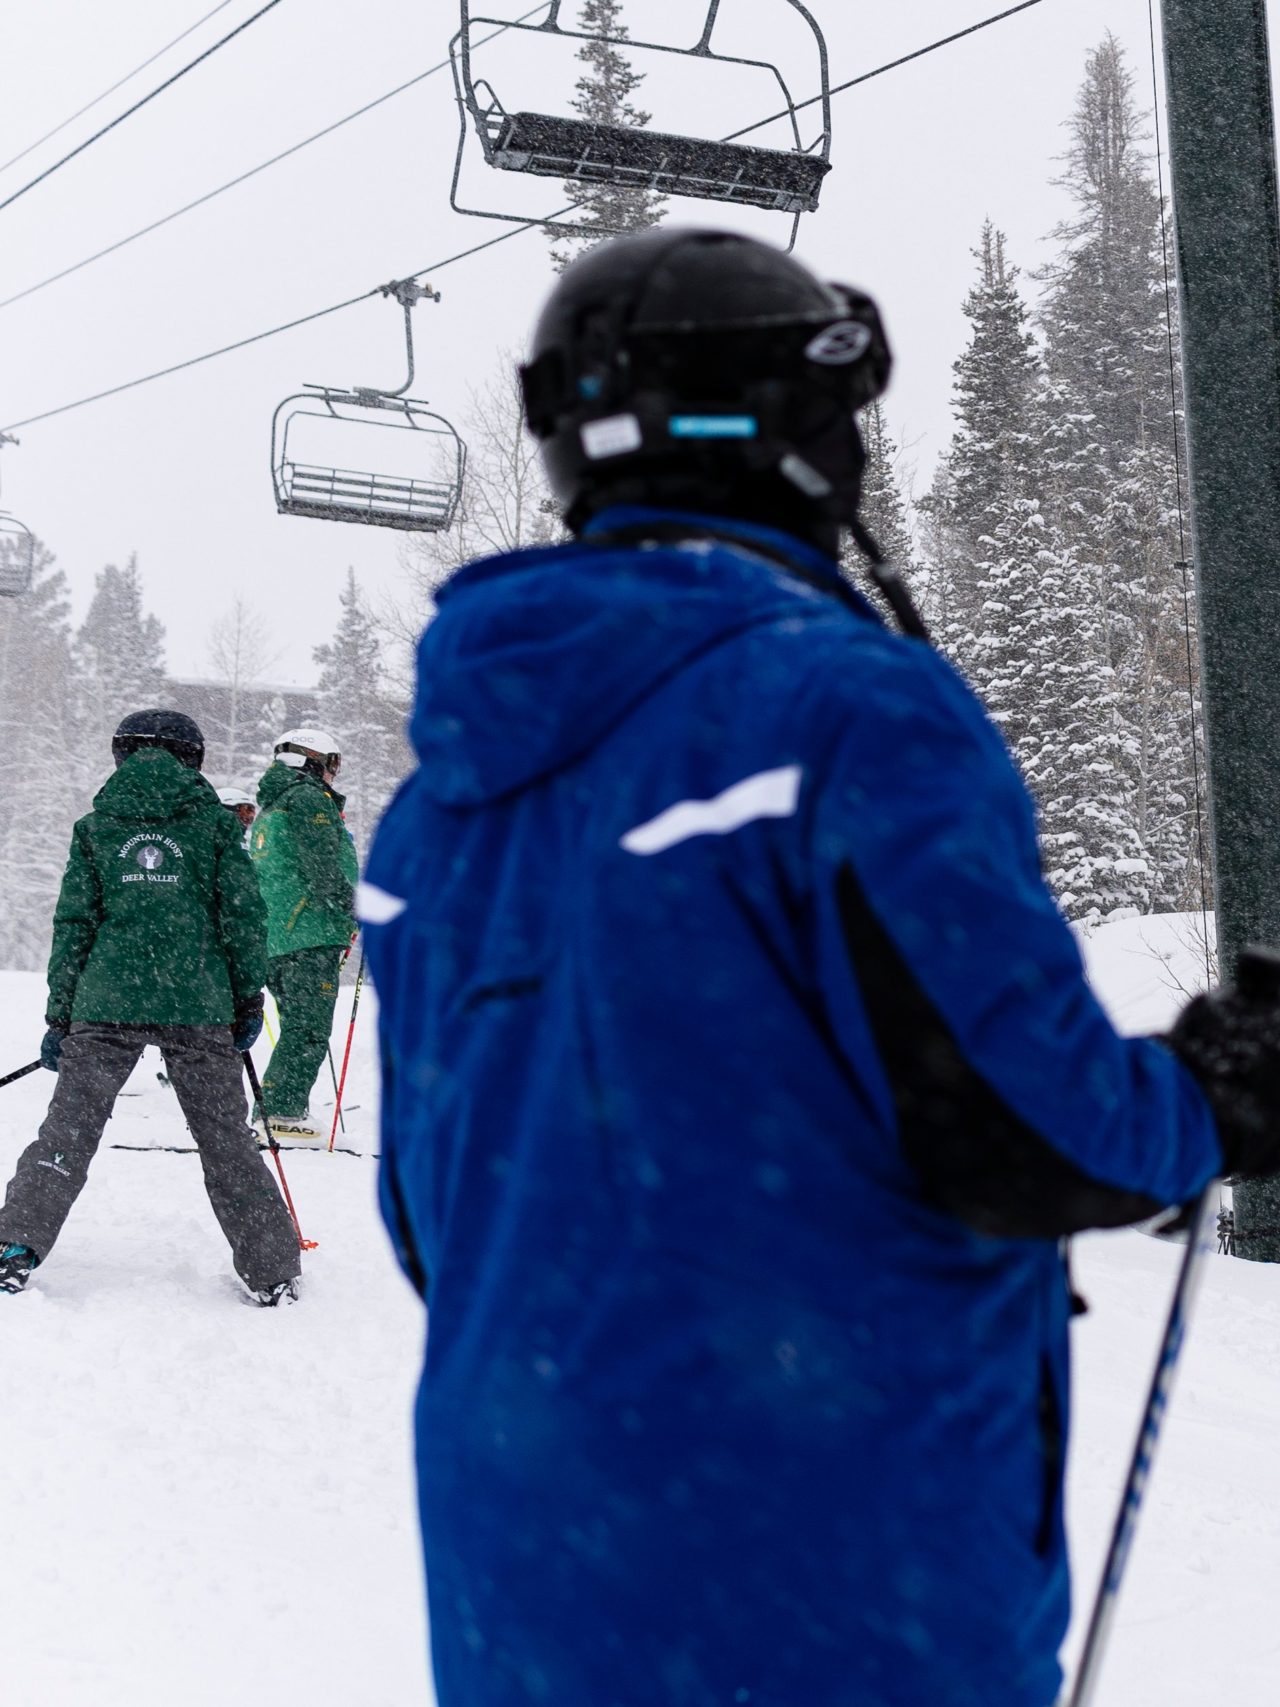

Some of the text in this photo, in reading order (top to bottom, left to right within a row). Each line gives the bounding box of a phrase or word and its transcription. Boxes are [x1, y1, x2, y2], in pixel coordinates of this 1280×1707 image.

[118, 833, 184, 858] MOUNTAIN HOST
[121, 874, 179, 883] DEER VALLEY
[269, 1123, 314, 1135] HEAD
